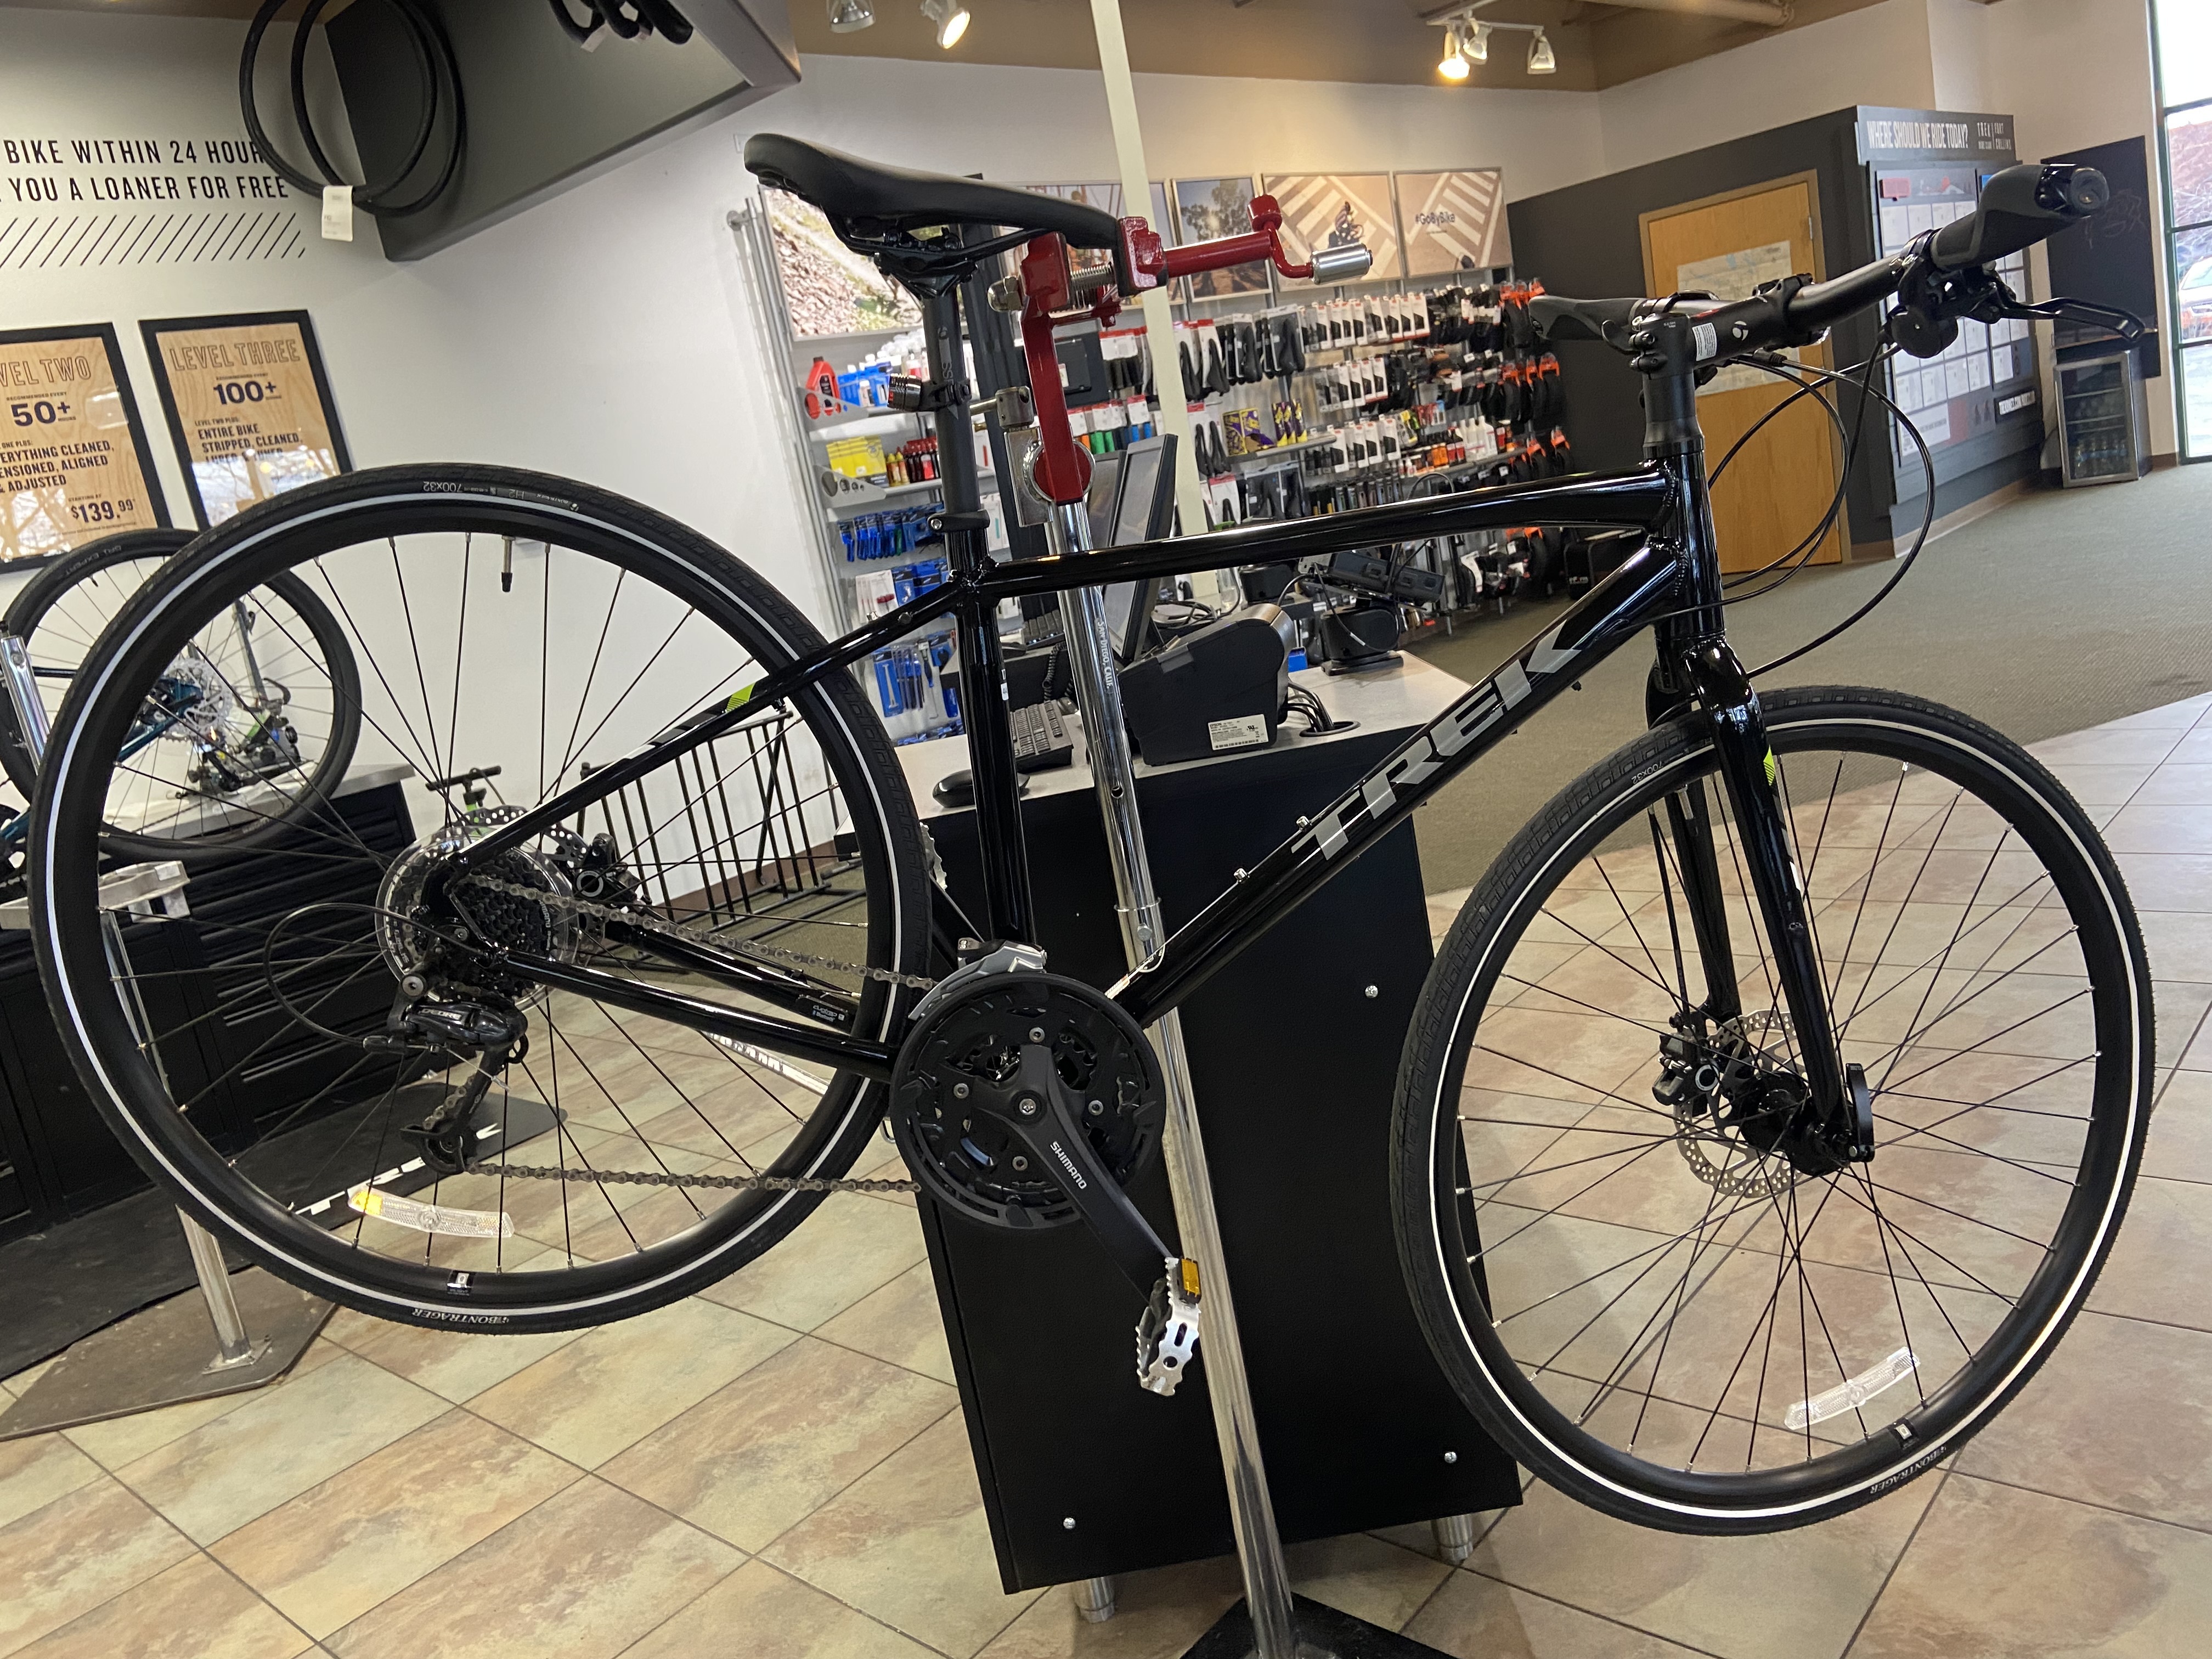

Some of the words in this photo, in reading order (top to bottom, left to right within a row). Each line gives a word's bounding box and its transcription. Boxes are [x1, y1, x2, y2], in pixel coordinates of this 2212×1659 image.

[1866, 121, 1893, 149] WHERE
[1893, 121, 1920, 149] SHOULD
[1920, 122, 1931, 149] WE
[1931, 123, 1946, 149] RIDE
[1945, 123, 1968, 149] TODAY?
[4, 140, 63, 163] BIKE
[71, 140, 161, 163] WITHIN
[170, 141, 196, 163] 24
[205, 141, 264, 163] HOUR
[8, 178, 58, 202] YOU
[69, 178, 83, 201] A
[91, 177, 180, 200] LOANER
[188, 177, 230, 199] FOR
[236, 176, 289, 199] FREE
[170, 345, 234, 371] LEVEL
[234, 338, 301, 366] THREE
[40, 356, 92, 383] TWO
[213, 380, 276, 405] 100+
[11, 401, 70, 427] 50+
[198, 426, 235, 440] ENTIRE
[236, 424, 261, 436] BIKE
[61, 440, 114, 456] CLEANED,
[202, 438, 255, 453] STRIPPED,
[61, 455, 108, 471] ALIGNED
[8, 475, 66, 492] ADJUSTED
[423, 481, 463, 493] 700x32
[509, 489, 525, 500] H2
[1097, 620, 1105, 639] SAN
[1101, 639, 1110, 667] DIEGO,
[1291, 619, 1581, 860] TREK
[1631, 760, 1663, 785] 700x32
[1050, 1141, 1087, 1189] SHIMANO
[411, 1307, 500, 1324] BONTRAGER
[1870, 1450, 1938, 1494] BONTRAGER
